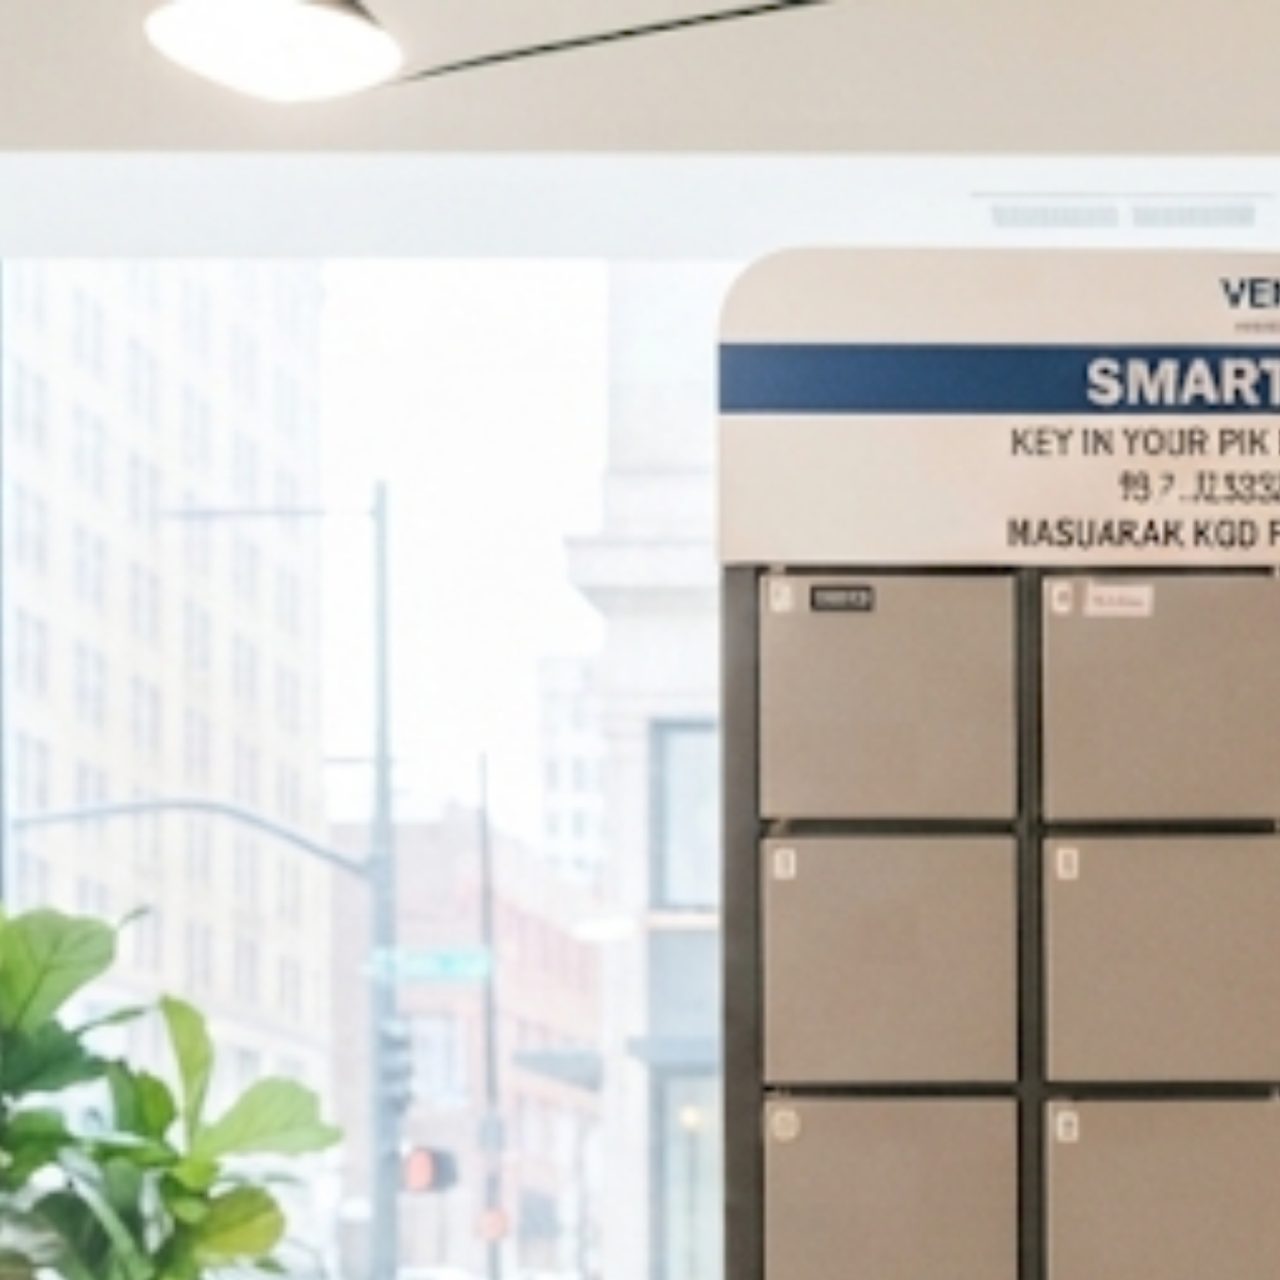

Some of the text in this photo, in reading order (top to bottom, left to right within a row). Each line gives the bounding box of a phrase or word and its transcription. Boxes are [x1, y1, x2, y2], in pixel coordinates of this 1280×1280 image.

[1011, 428, 1073, 457] KEY
[1082, 428, 1114, 457] IN
[1122, 428, 1209, 457] YOUR
